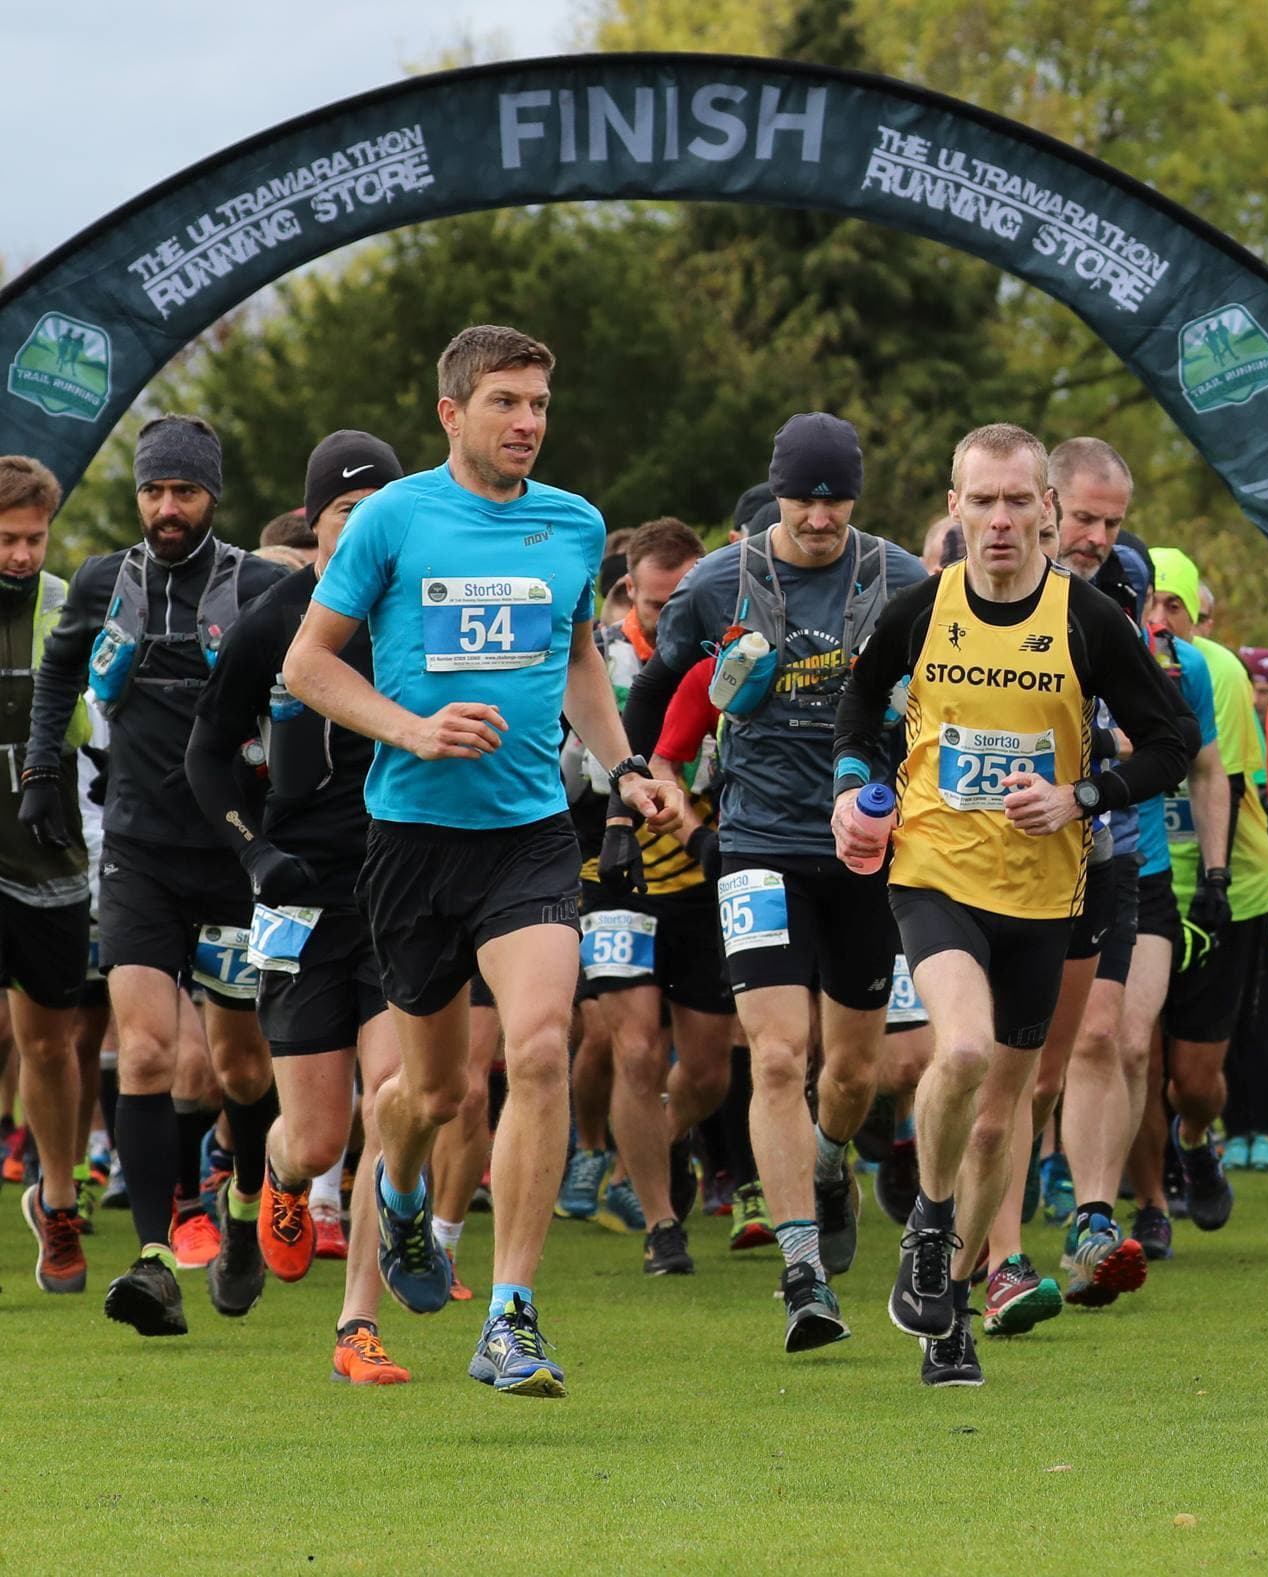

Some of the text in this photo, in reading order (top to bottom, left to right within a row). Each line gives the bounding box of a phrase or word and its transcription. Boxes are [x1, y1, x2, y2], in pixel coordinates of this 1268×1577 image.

[499, 83, 827, 169] FINISH
[128, 124, 425, 280] THE ULTRAMARATHON
[878, 125, 1170, 278] THE ULTRAMARATHON
[146, 153, 435, 320] RUNNING STORE
[861, 155, 1151, 313] RUNNING STORE
[16, 369, 100, 406] TRAIL RUNNING
[1191, 378, 1223, 398] TRAIL
[464, 583, 512, 597] Stort30
[459, 605, 515, 652] 54
[813, 630, 840, 646] MONEY
[926, 663, 1065, 693] STOCKPORT
[974, 734, 1020, 750] Stort30
[719, 874, 749, 894] Stort30
[721, 895, 753, 941] 95
[593, 931, 633, 963] 58
